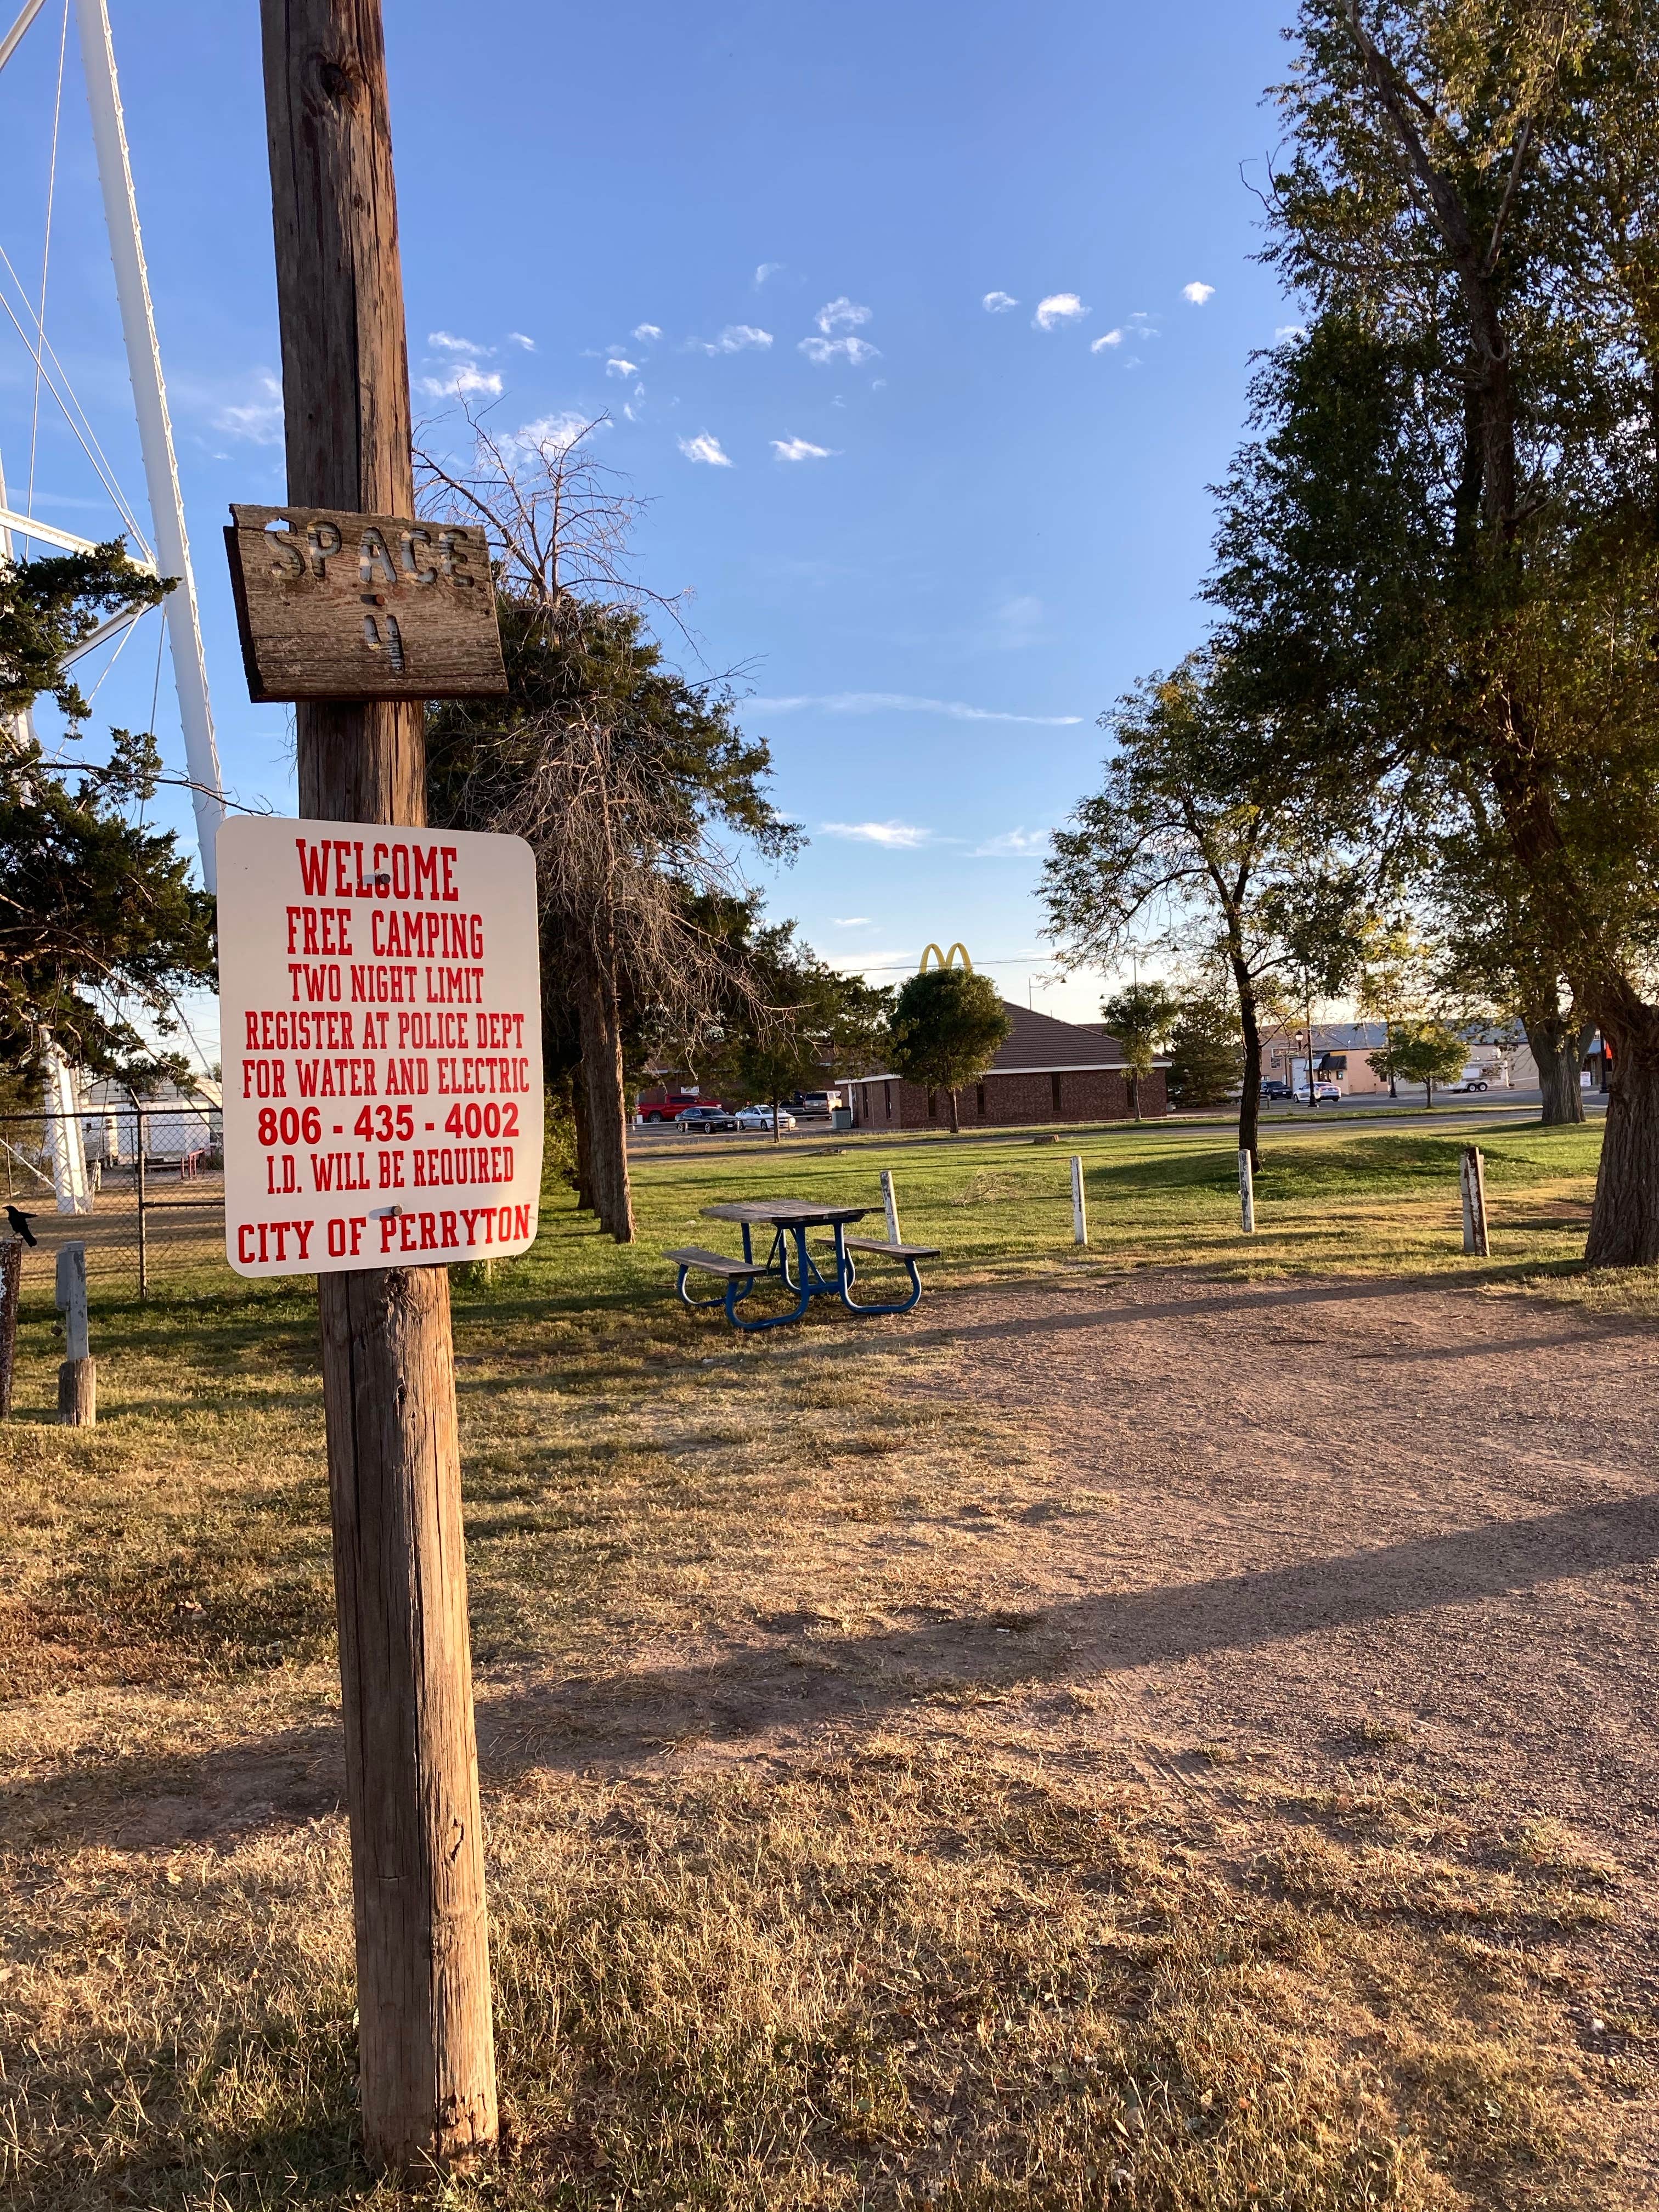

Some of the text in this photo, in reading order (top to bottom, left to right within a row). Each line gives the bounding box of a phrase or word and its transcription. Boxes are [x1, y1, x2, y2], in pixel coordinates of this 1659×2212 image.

[264, 517, 475, 588] SPACE
[296, 839, 459, 901] WELCOME
[286, 906, 483, 959] FREE CAMPING
[288, 963, 483, 1003] TWO NIGHT LIMIT
[245, 1011, 524, 1049] REGISTER AT POLICE DEPT
[242, 1058, 529, 1098] FOR WATER AND ELECTRIC
[258, 1107, 321, 1146] 806
[354, 1104, 414, 1142] 435
[445, 1102, 518, 1138] 4002
[267, 1147, 513, 1194] I.D. WILL BE REQUIRED
[238, 1204, 530, 1263] CITY OF PERRYTON
